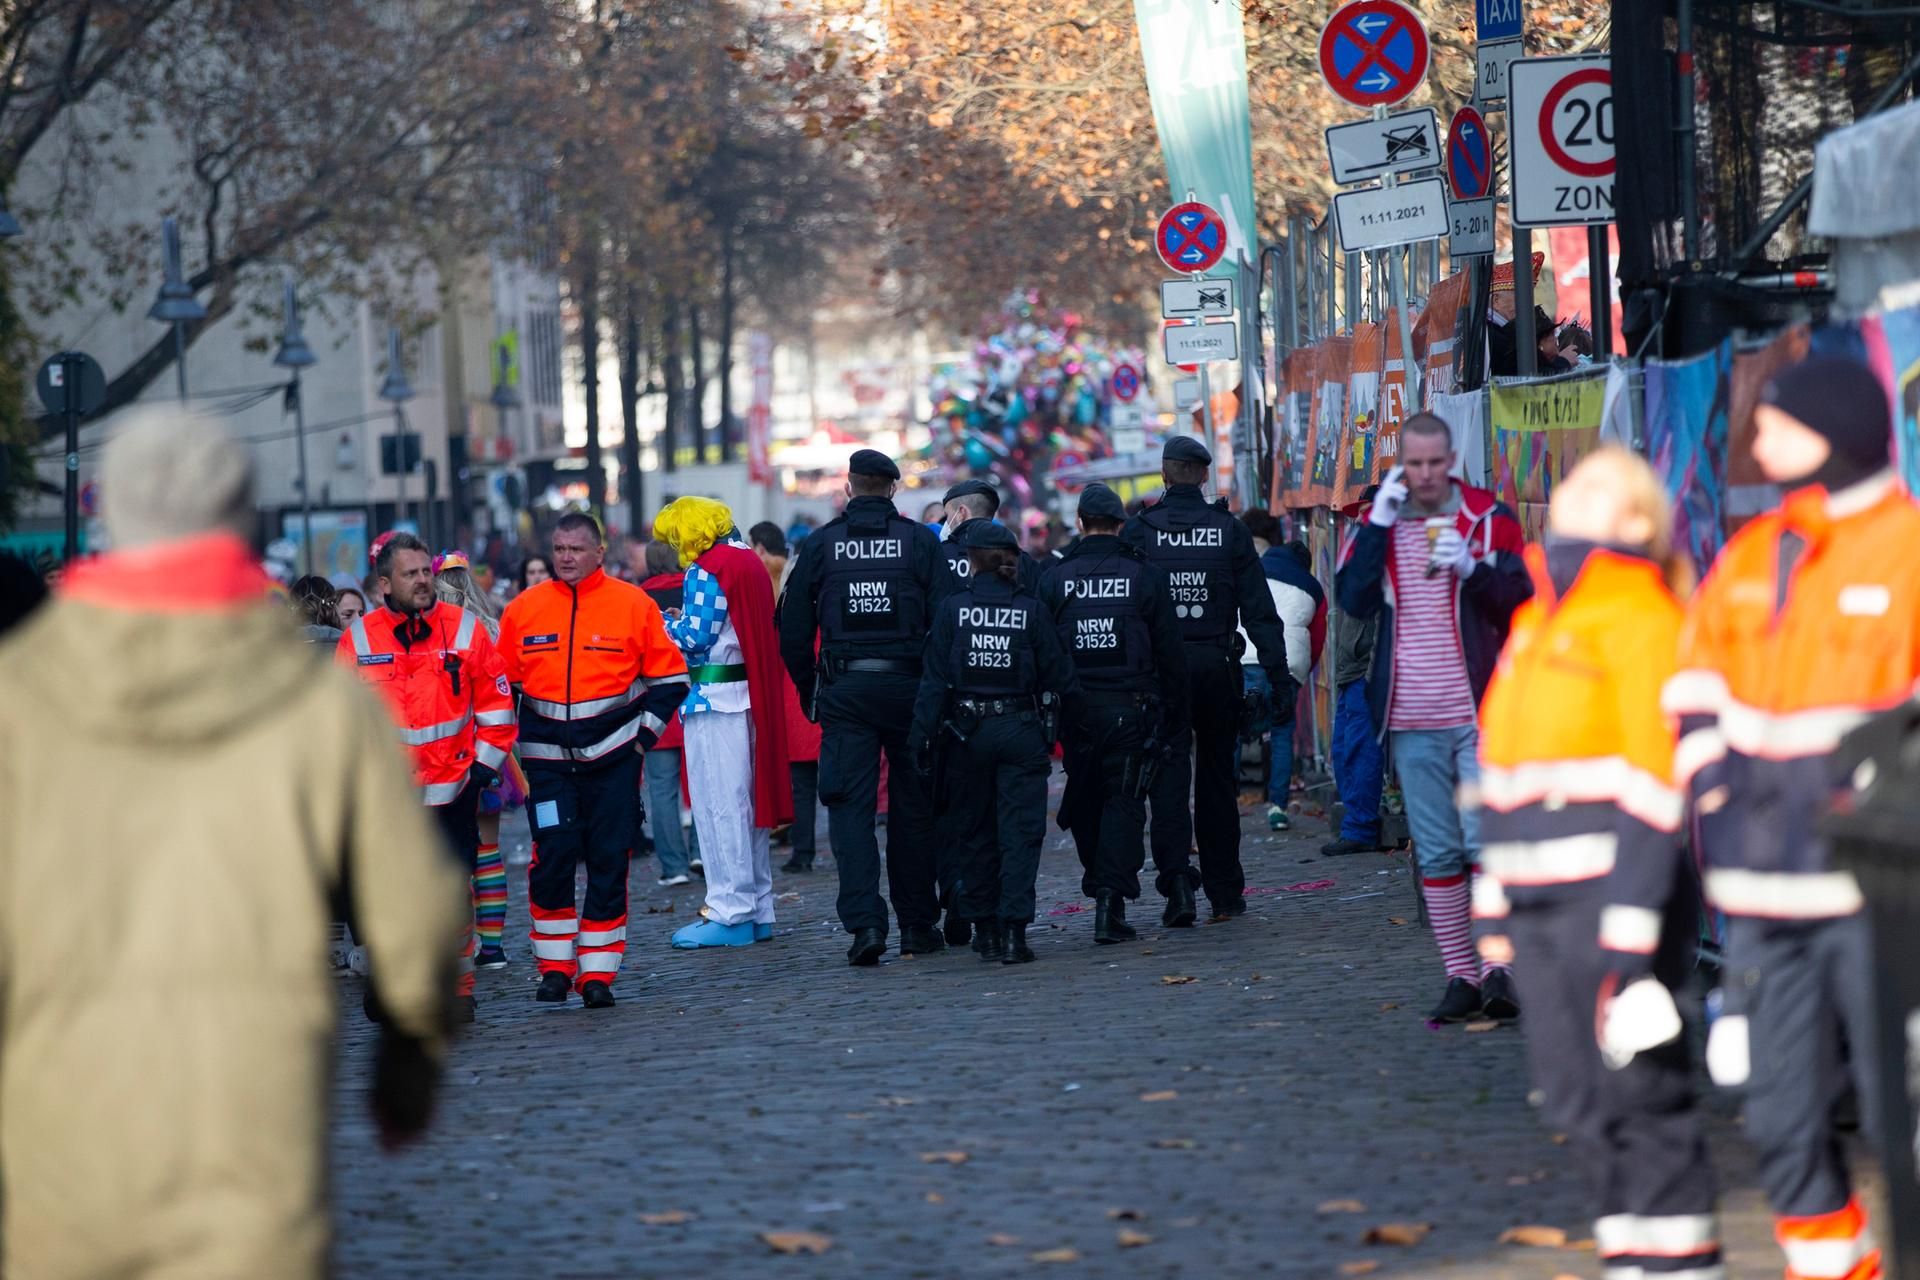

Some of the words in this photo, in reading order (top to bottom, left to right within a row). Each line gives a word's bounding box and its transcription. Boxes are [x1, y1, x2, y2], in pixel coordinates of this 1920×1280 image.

[1485, 61, 1498, 85] 20
[1563, 96, 1615, 147] 20
[1359, 205, 1425, 226] 11.11.2021
[1455, 220, 1460, 236] 5
[1469, 217, 1480, 234] 20
[1483, 216, 1489, 231] h
[1179, 338, 1223, 348] 11.11.2021
[1157, 528, 1222, 546] POLIZEI
[834, 539, 902, 560] POLIZEI
[1169, 572, 1206, 586] NRW
[849, 581, 887, 597] NRW
[1064, 578, 1130, 598] POLIZEI
[1169, 587, 1208, 602] 31523
[849, 597, 891, 613] 31522
[958, 606, 1027, 630] POLIZEI
[1077, 617, 1113, 634] NRW
[971, 633, 1010, 650] NRW
[1075, 633, 1117, 649] 31523
[967, 651, 1011, 667] 31523
